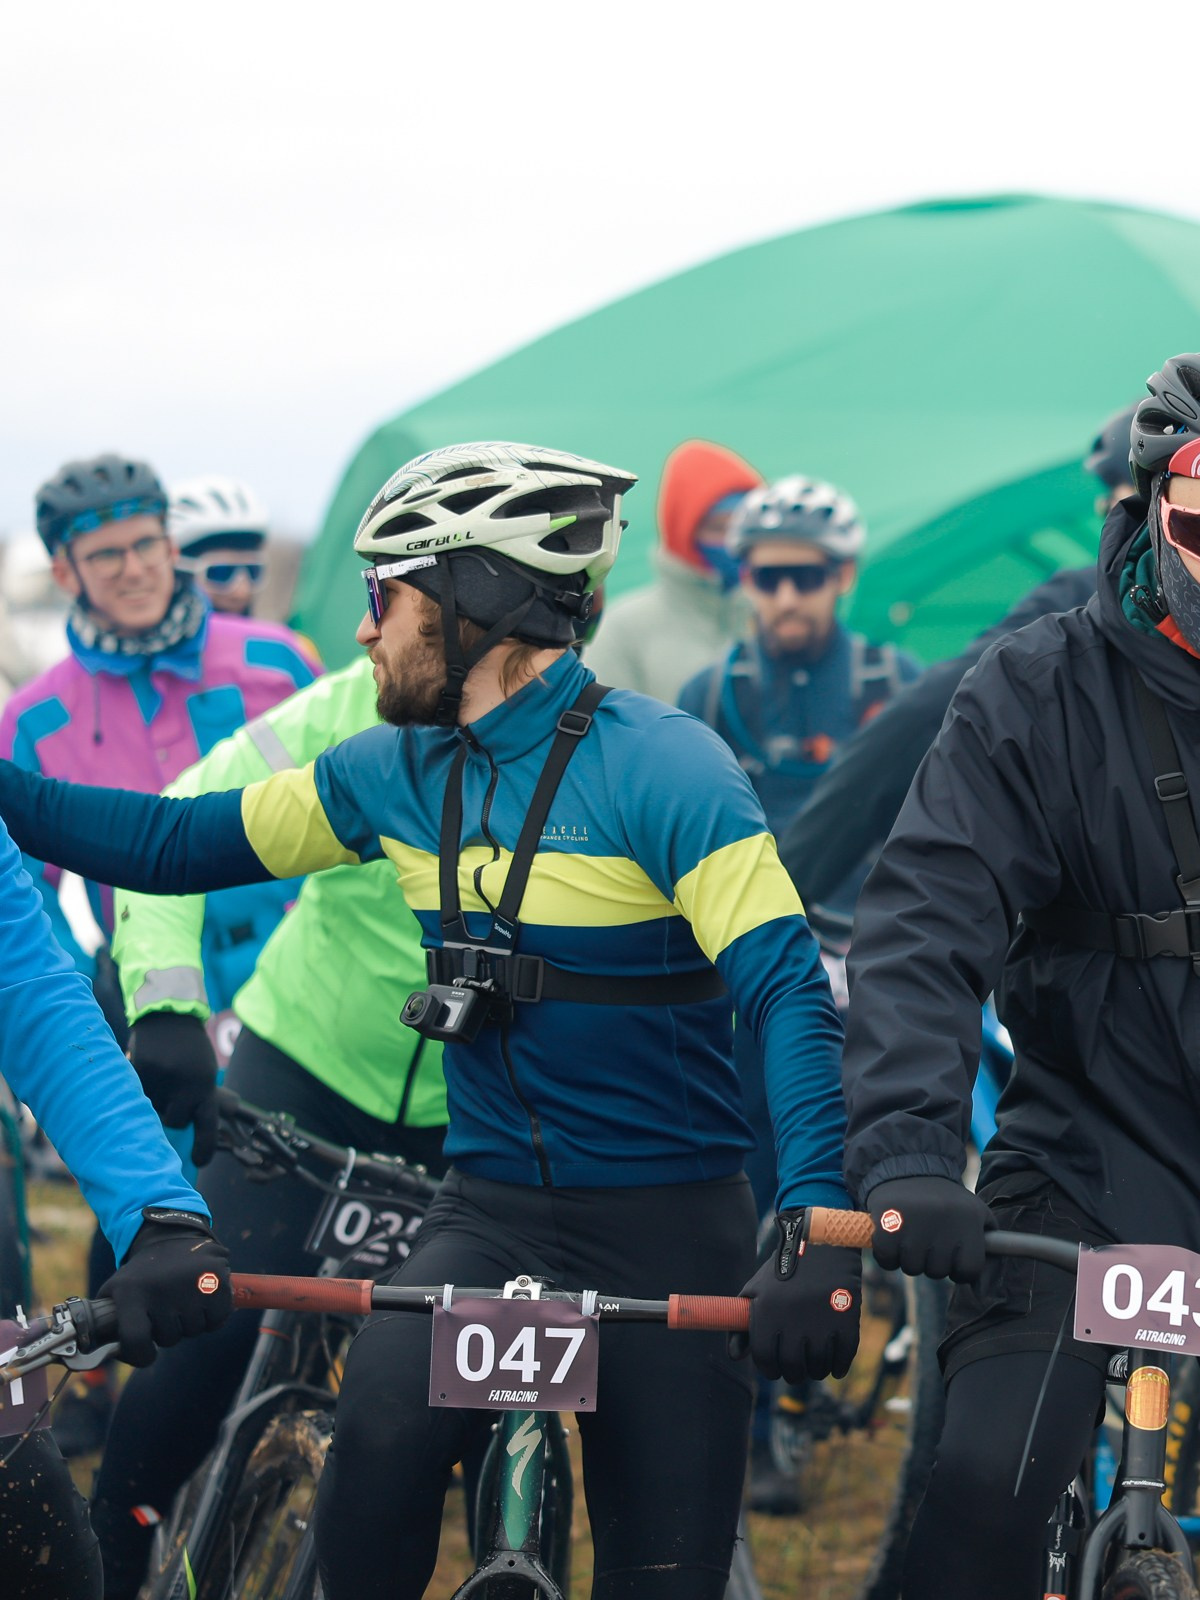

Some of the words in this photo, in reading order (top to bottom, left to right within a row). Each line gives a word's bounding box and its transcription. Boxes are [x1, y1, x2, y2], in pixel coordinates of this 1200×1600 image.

[1135, 1329, 1186, 1346] FATRACING
[456, 1323, 586, 1384] 047
[488, 1390, 539, 1403] FATRACING
